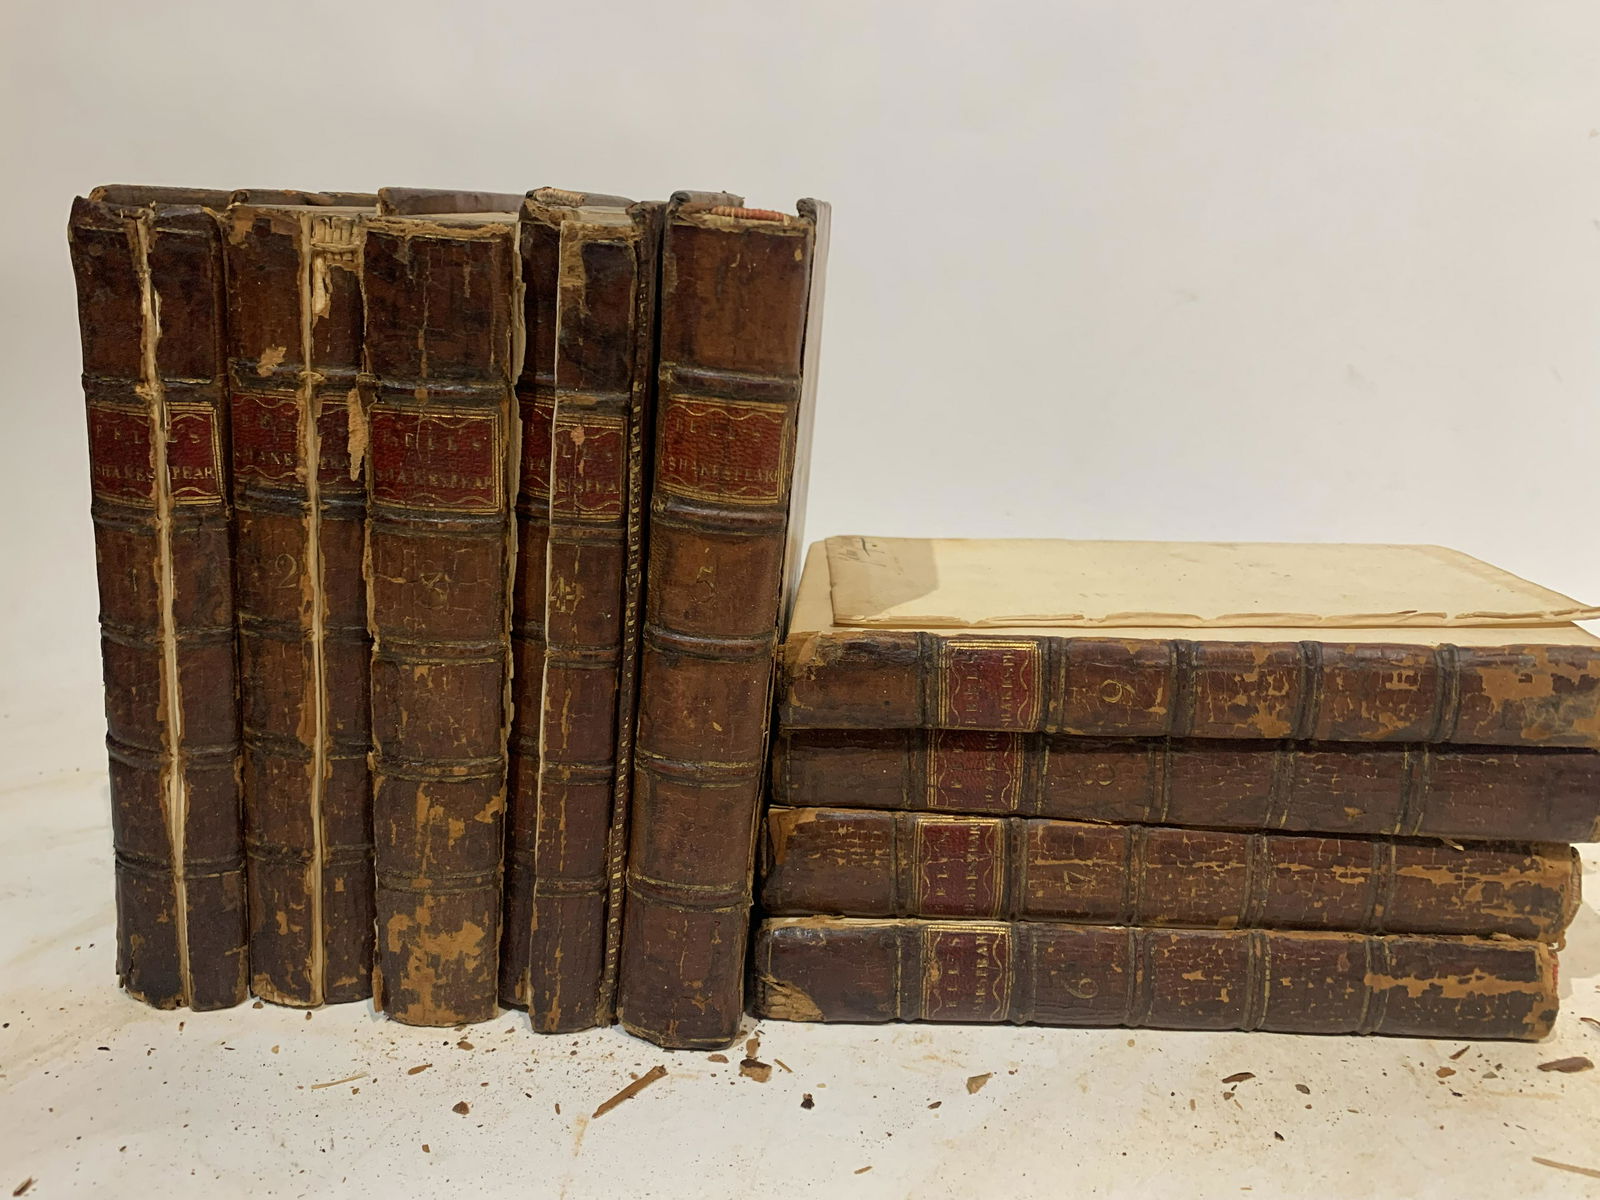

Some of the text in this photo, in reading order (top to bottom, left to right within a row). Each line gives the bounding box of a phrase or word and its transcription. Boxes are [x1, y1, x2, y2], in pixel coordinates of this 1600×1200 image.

[274, 553, 297, 589] 2
[1099, 678, 1136, 703] 9
[1063, 870, 1097, 891] 7
[1061, 977, 1099, 999] 6
